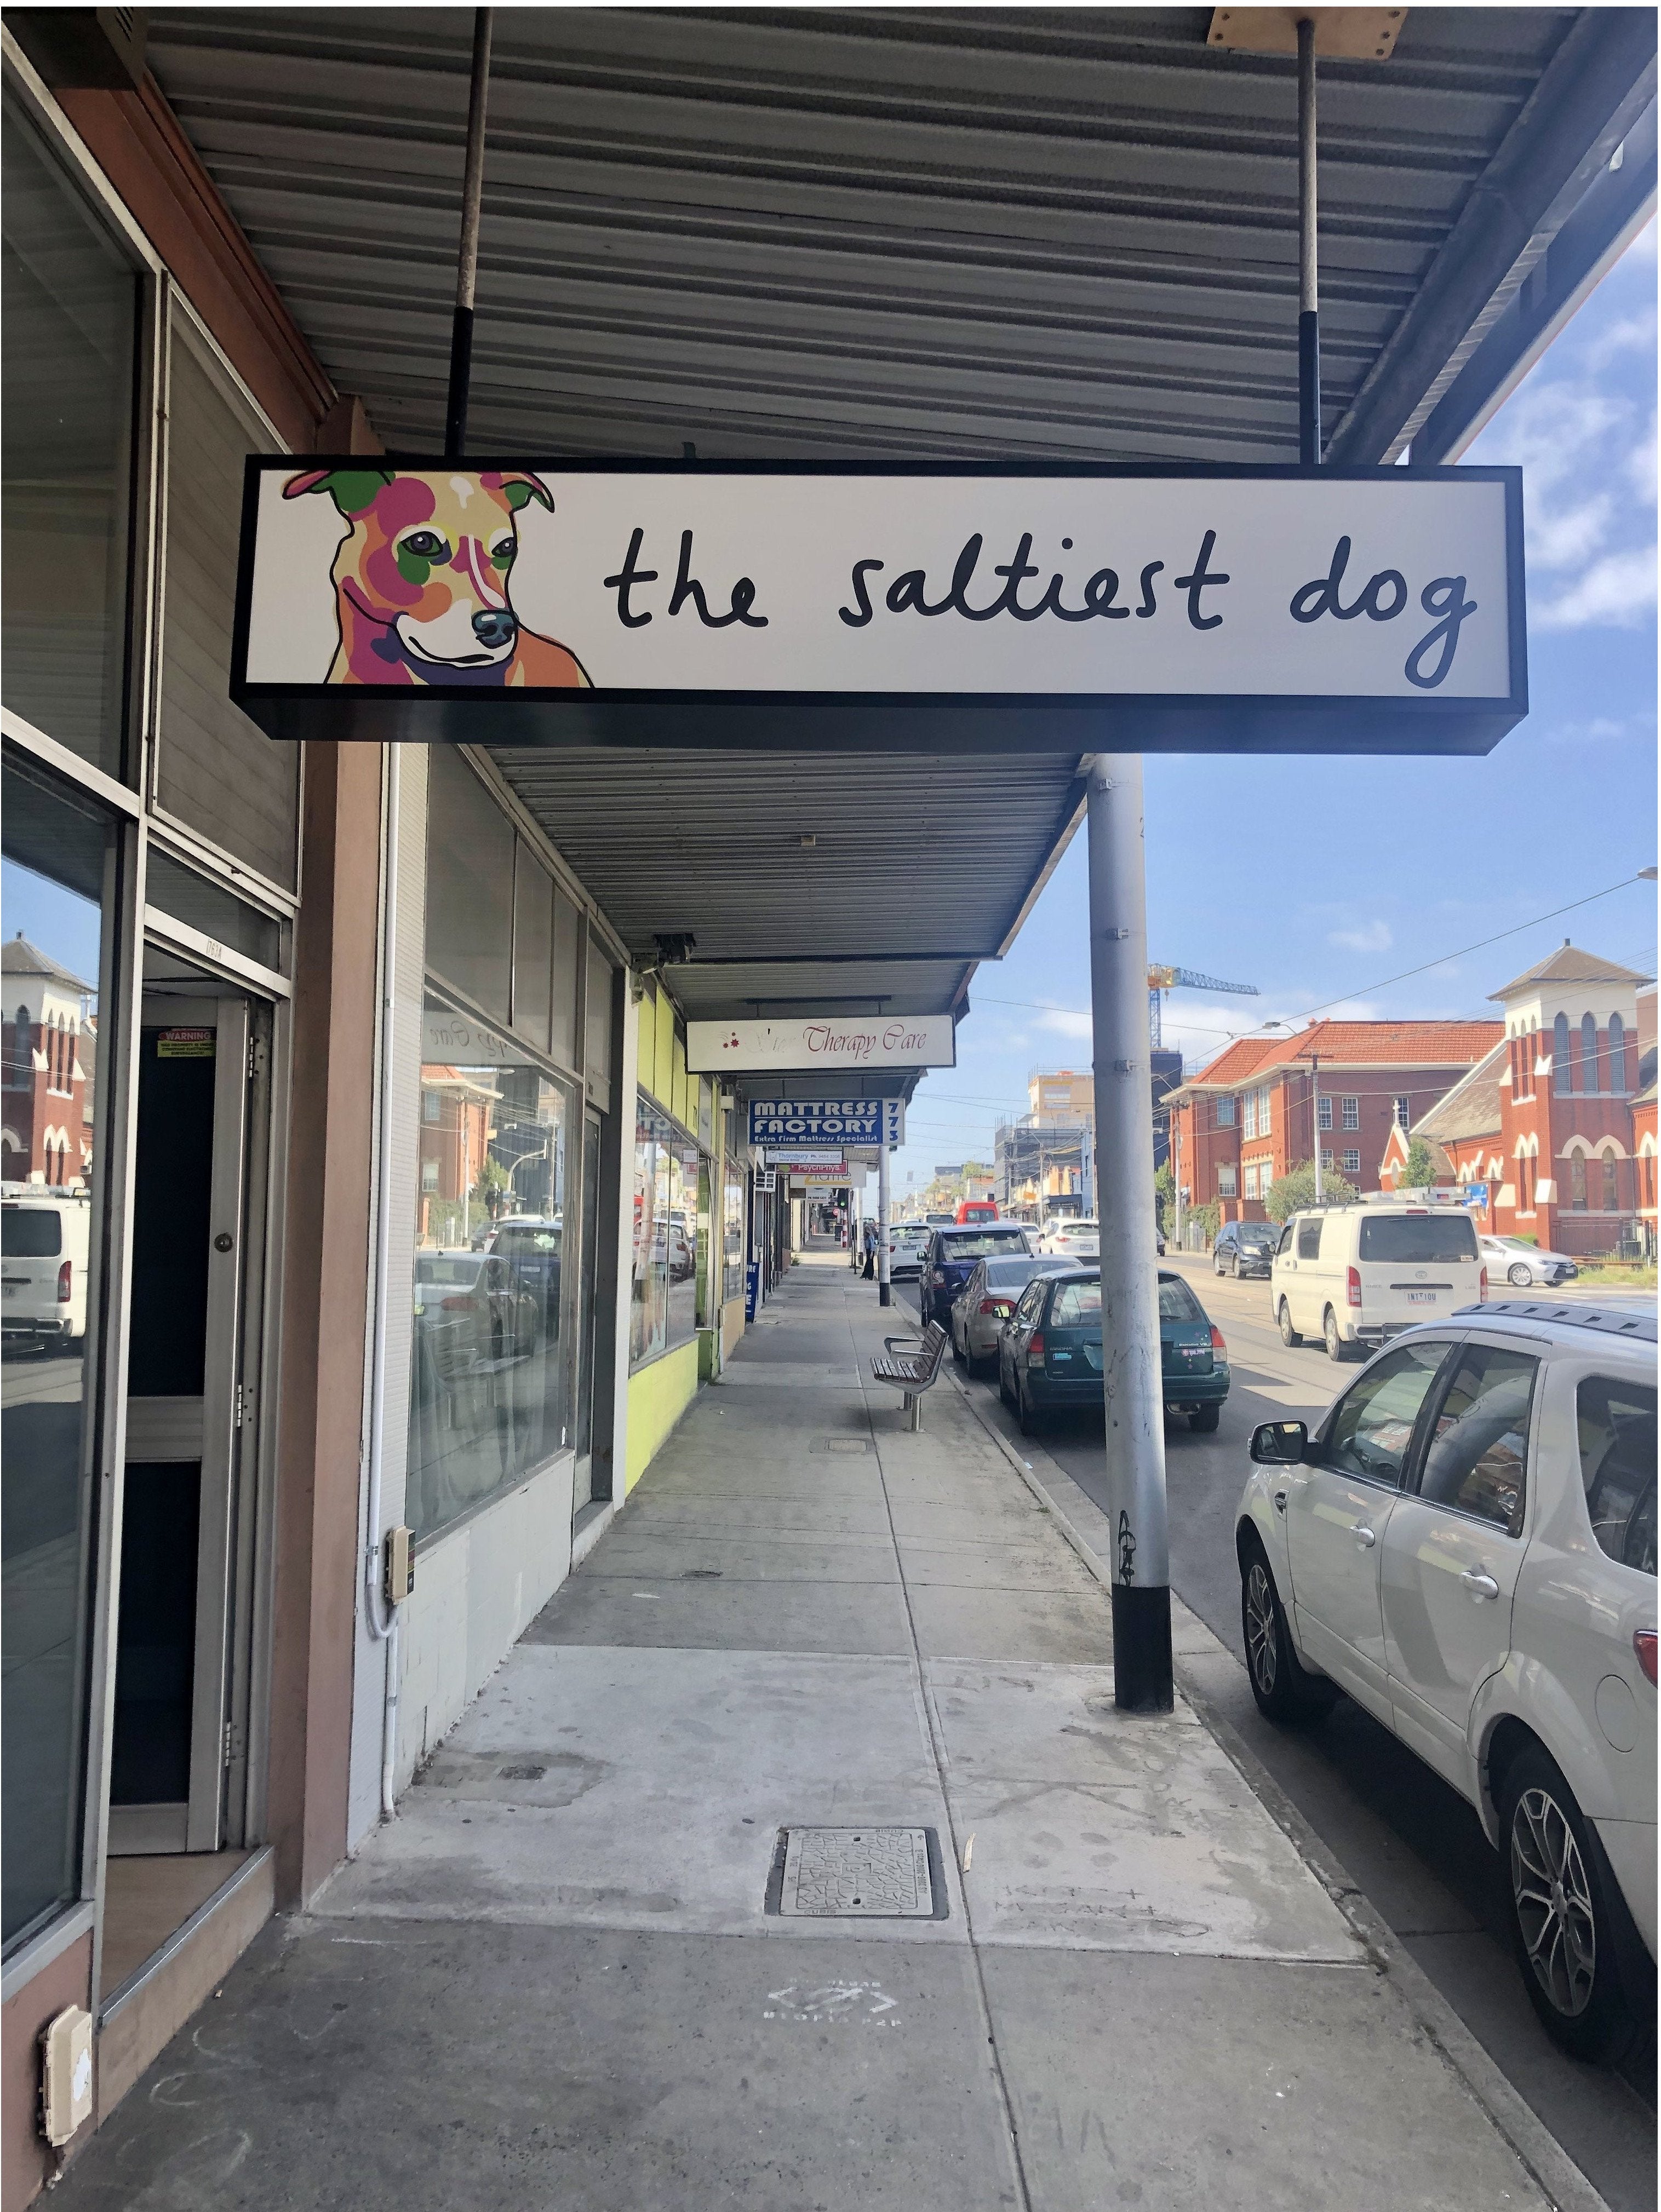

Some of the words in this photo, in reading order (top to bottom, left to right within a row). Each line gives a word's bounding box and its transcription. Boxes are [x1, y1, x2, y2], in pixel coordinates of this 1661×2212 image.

[604, 527, 769, 628] the
[838, 530, 1230, 630] saltiest
[1290, 536, 1477, 689] dog
[165, 1032, 211, 1040] WARNING
[803, 1026, 877, 1060] Therapy
[883, 1024, 927, 1050] Care
[754, 1102, 878, 1116] MATTRESS
[754, 1119, 877, 1133] FACTORY
